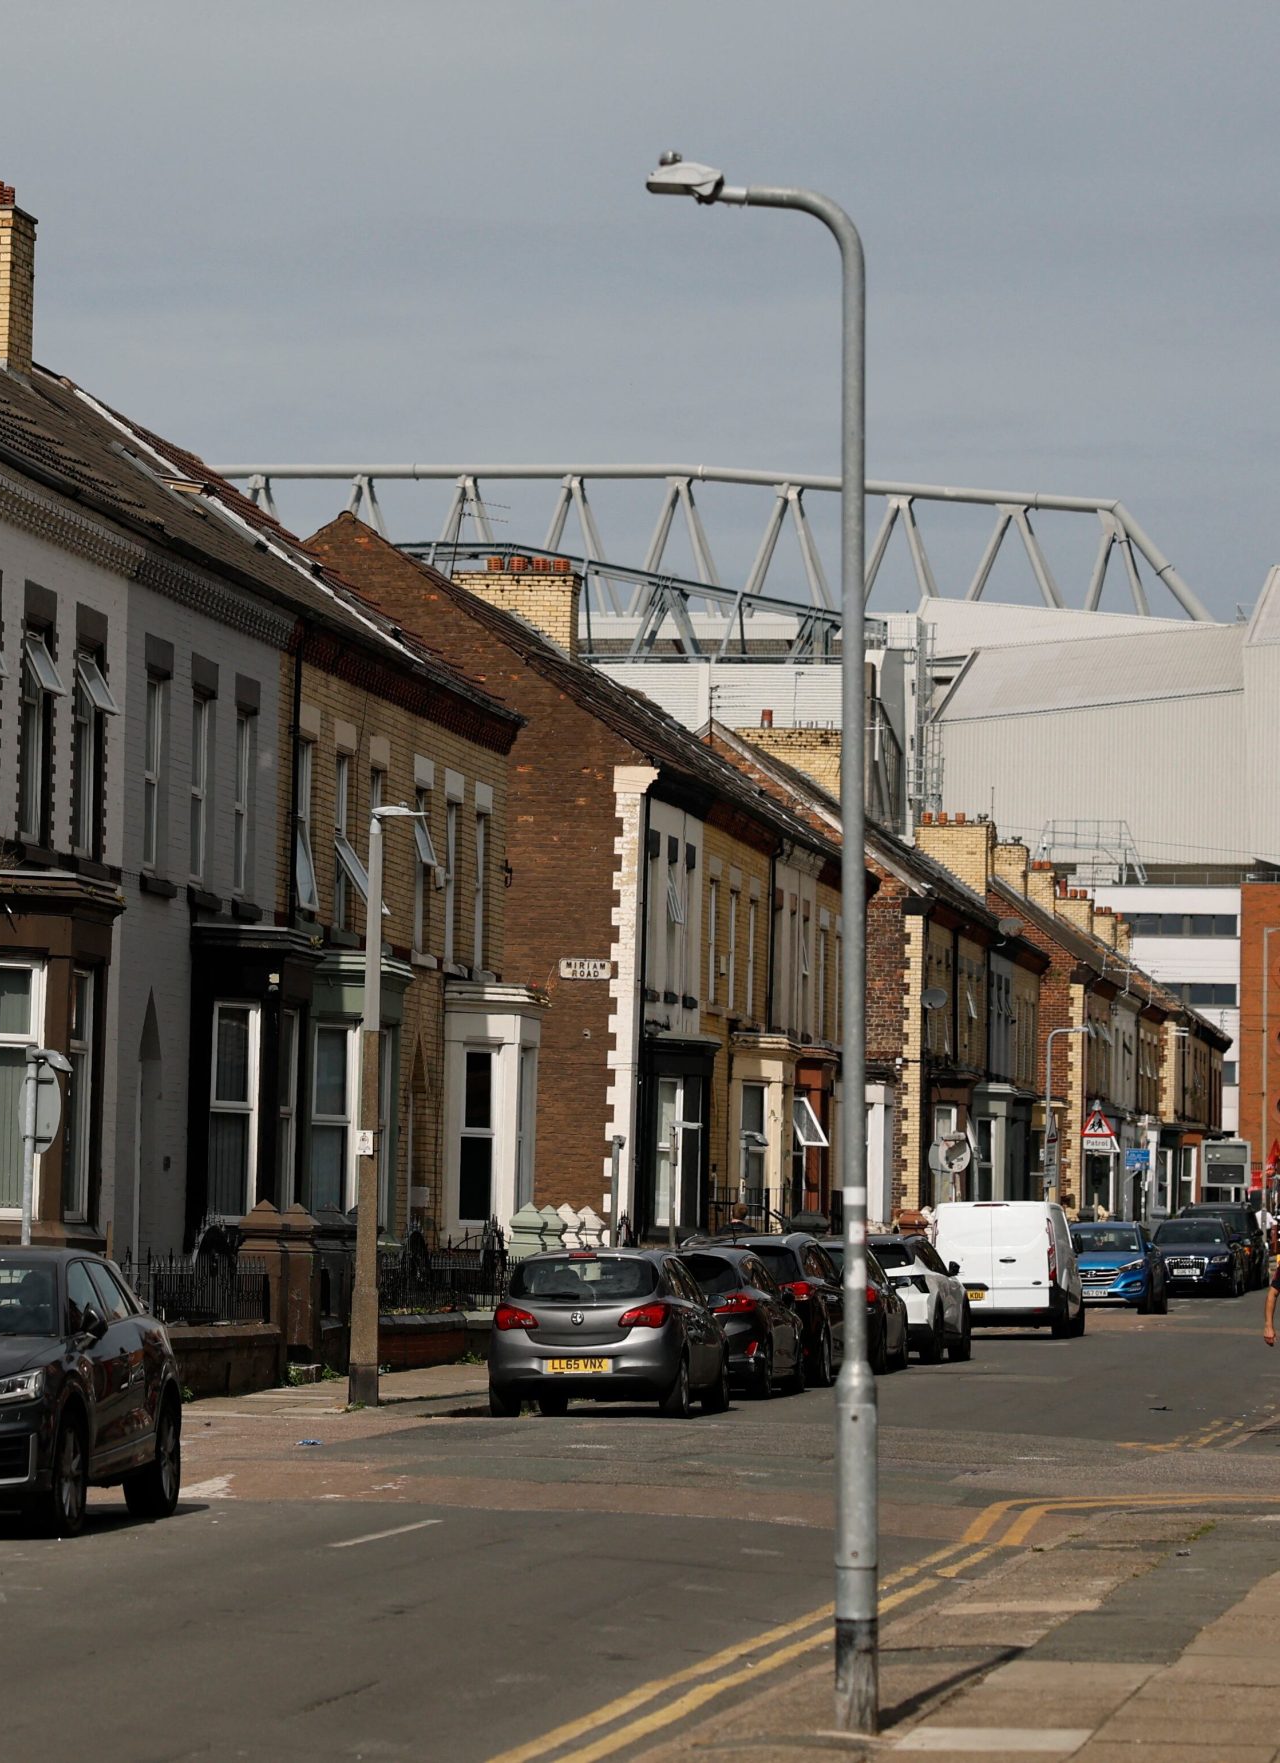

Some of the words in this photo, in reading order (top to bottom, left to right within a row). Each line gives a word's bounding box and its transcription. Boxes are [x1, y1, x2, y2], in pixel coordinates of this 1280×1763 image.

[566, 962, 606, 970] MIRIAM
[1086, 1139, 1108, 1147] Patrol
[551, 1359, 580, 1370] LL65
[582, 1359, 604, 1370] VNX
